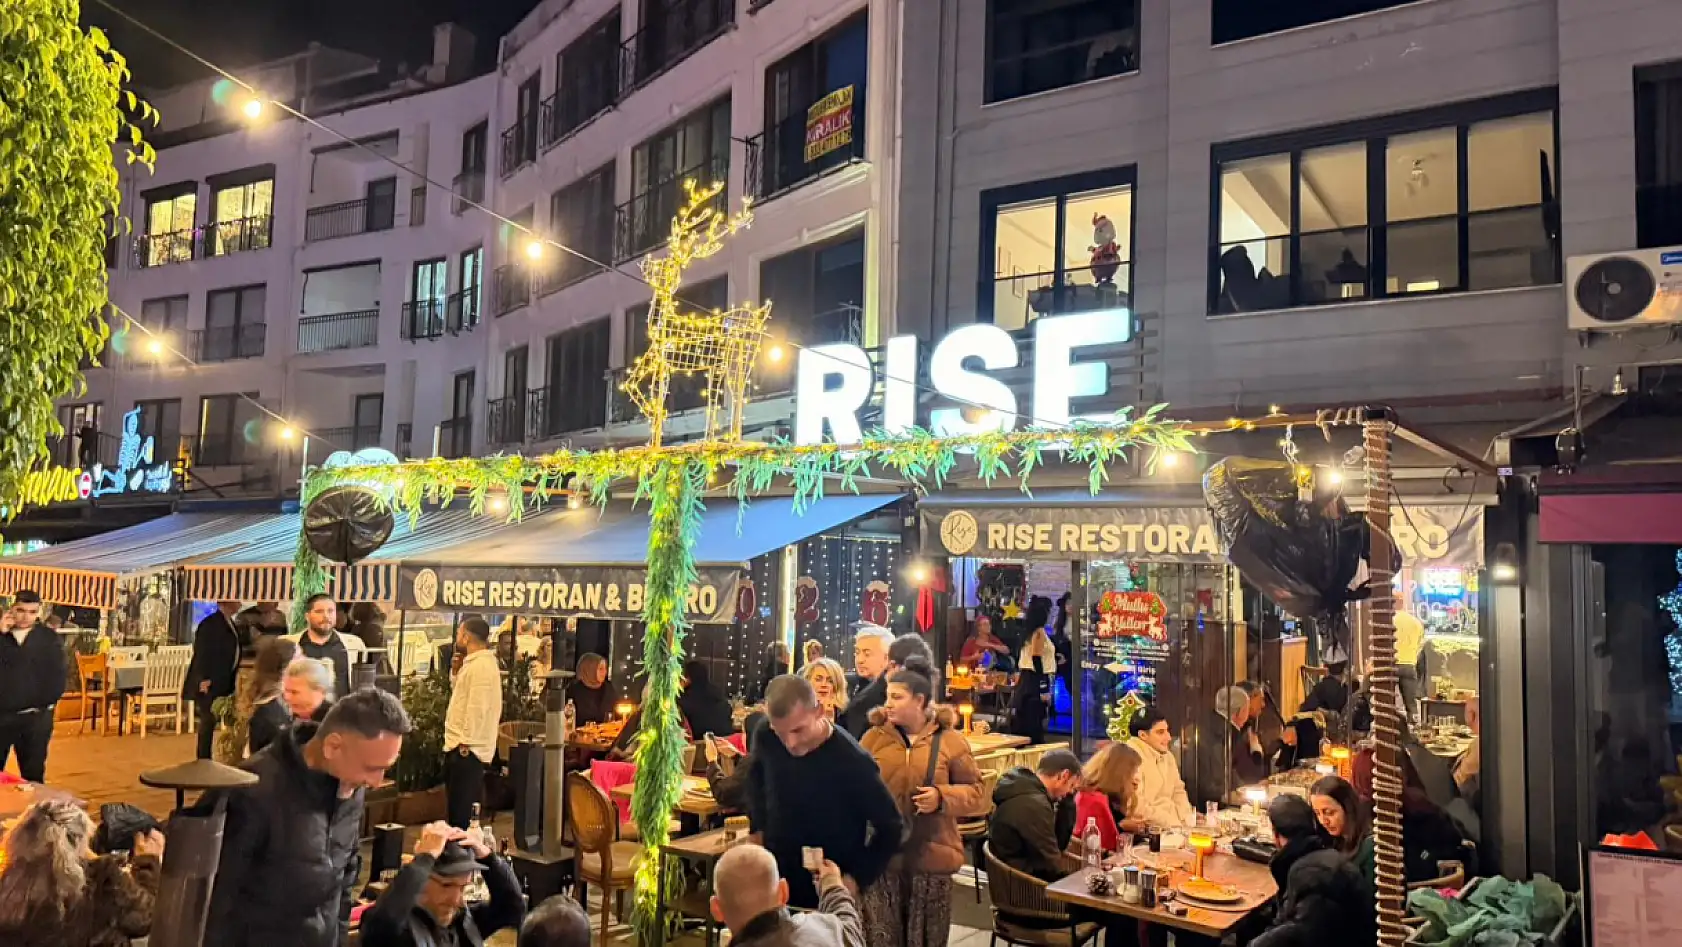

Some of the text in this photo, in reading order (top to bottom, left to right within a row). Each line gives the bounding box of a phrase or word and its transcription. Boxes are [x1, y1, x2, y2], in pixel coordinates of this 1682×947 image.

[796, 308, 1132, 455] RISE
[988, 523, 1220, 553] RISE RESTORA
[443, 580, 486, 607] RISE
[489, 581, 602, 610] RESTORAN
[605, 583, 621, 611] &
